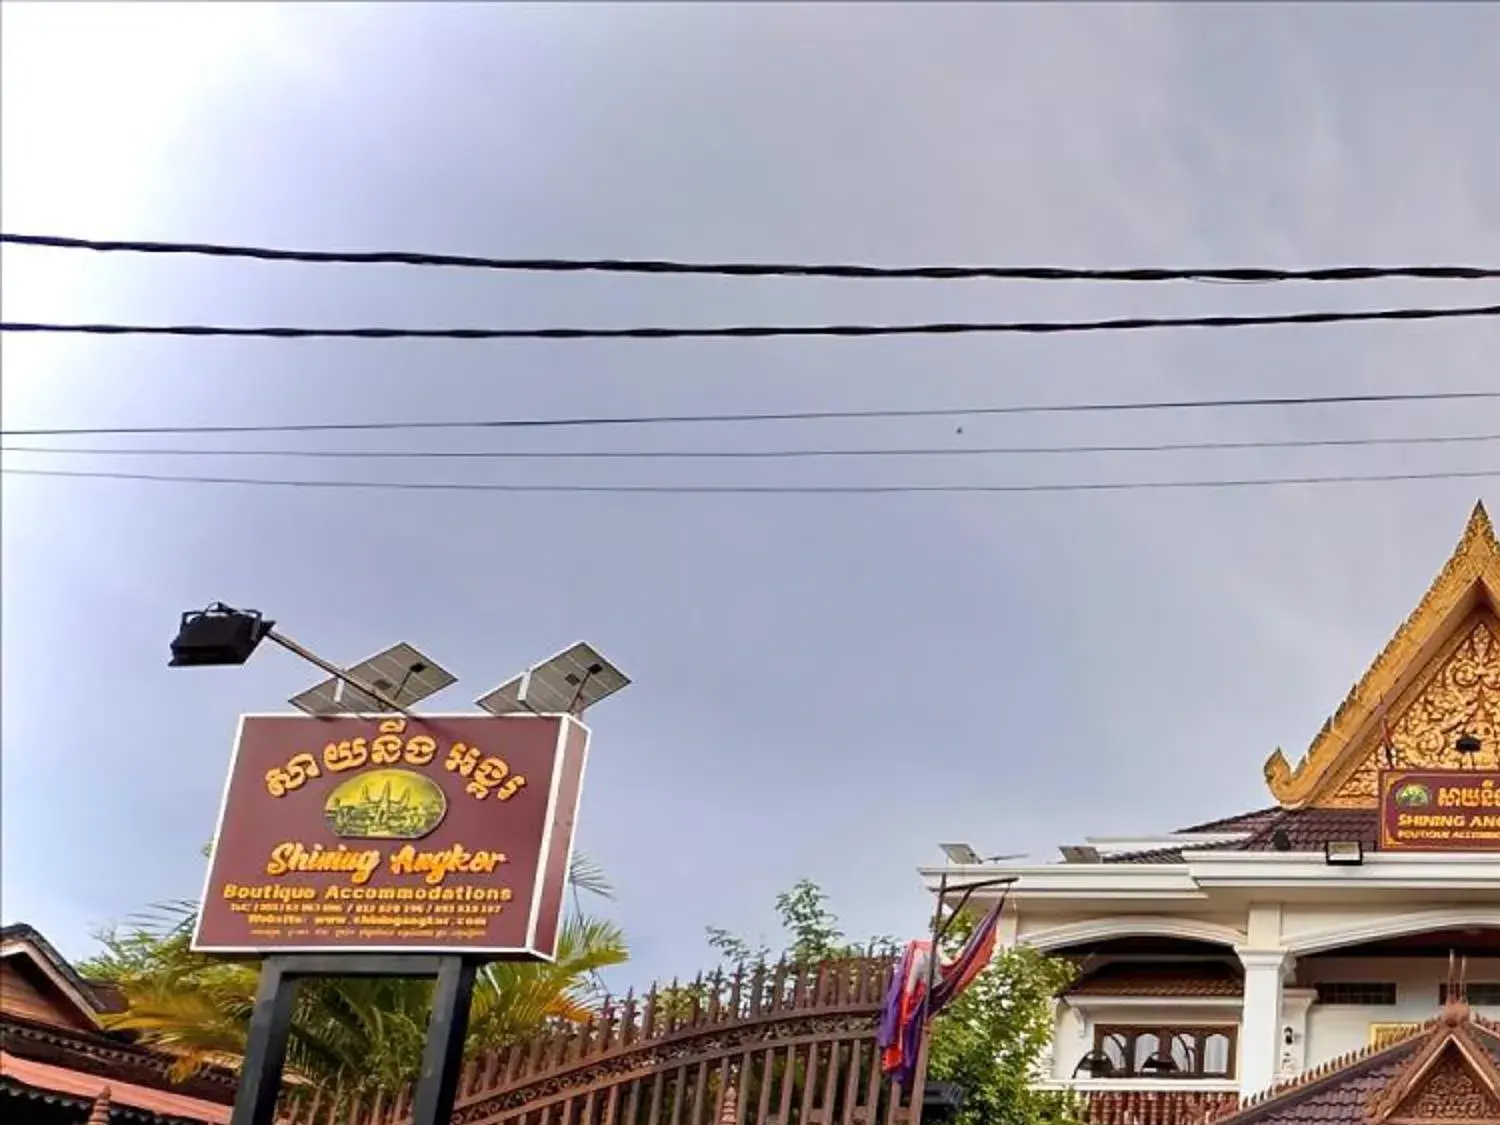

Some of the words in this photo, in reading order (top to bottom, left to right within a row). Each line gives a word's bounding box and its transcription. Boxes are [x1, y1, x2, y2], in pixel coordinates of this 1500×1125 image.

[1397, 814, 1465, 828] SHINING
[266, 841, 381, 884] Shining
[389, 842, 507, 884] Angkor
[223, 883, 317, 903] Boutique
[324, 884, 513, 901] Accommodations
